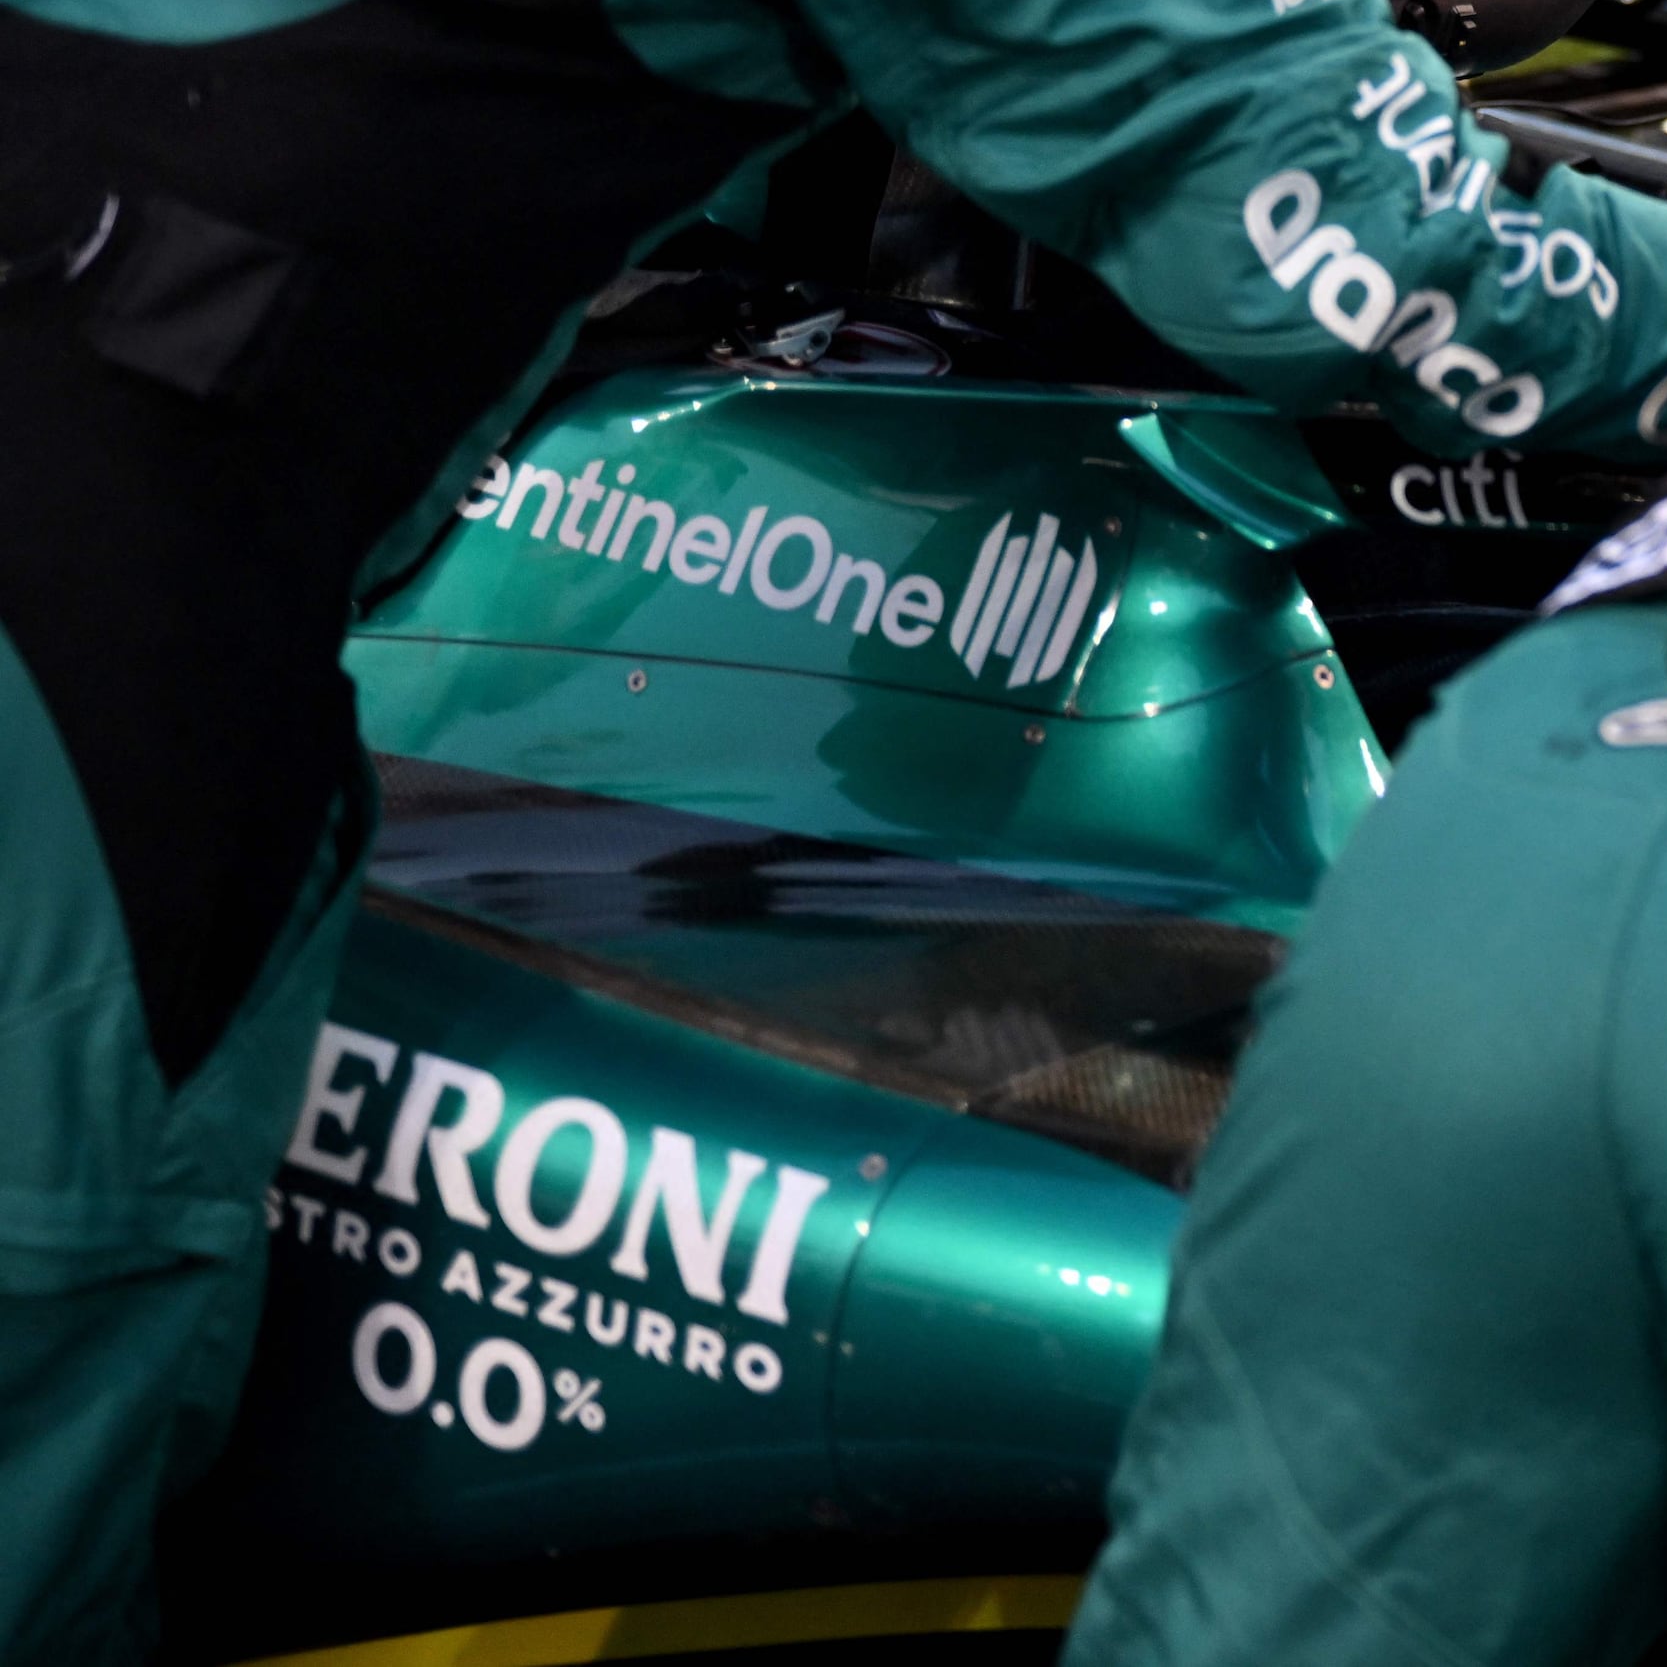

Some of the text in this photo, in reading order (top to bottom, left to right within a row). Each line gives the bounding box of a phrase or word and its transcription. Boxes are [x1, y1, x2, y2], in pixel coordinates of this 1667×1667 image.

[455, 453, 945, 648] entinelOne
[1390, 447, 1529, 528] citi
[284, 1023, 830, 1327] ERONI
[351, 1300, 608, 1453] 0.0%
[441, 1250, 784, 1396] AZZURRO
